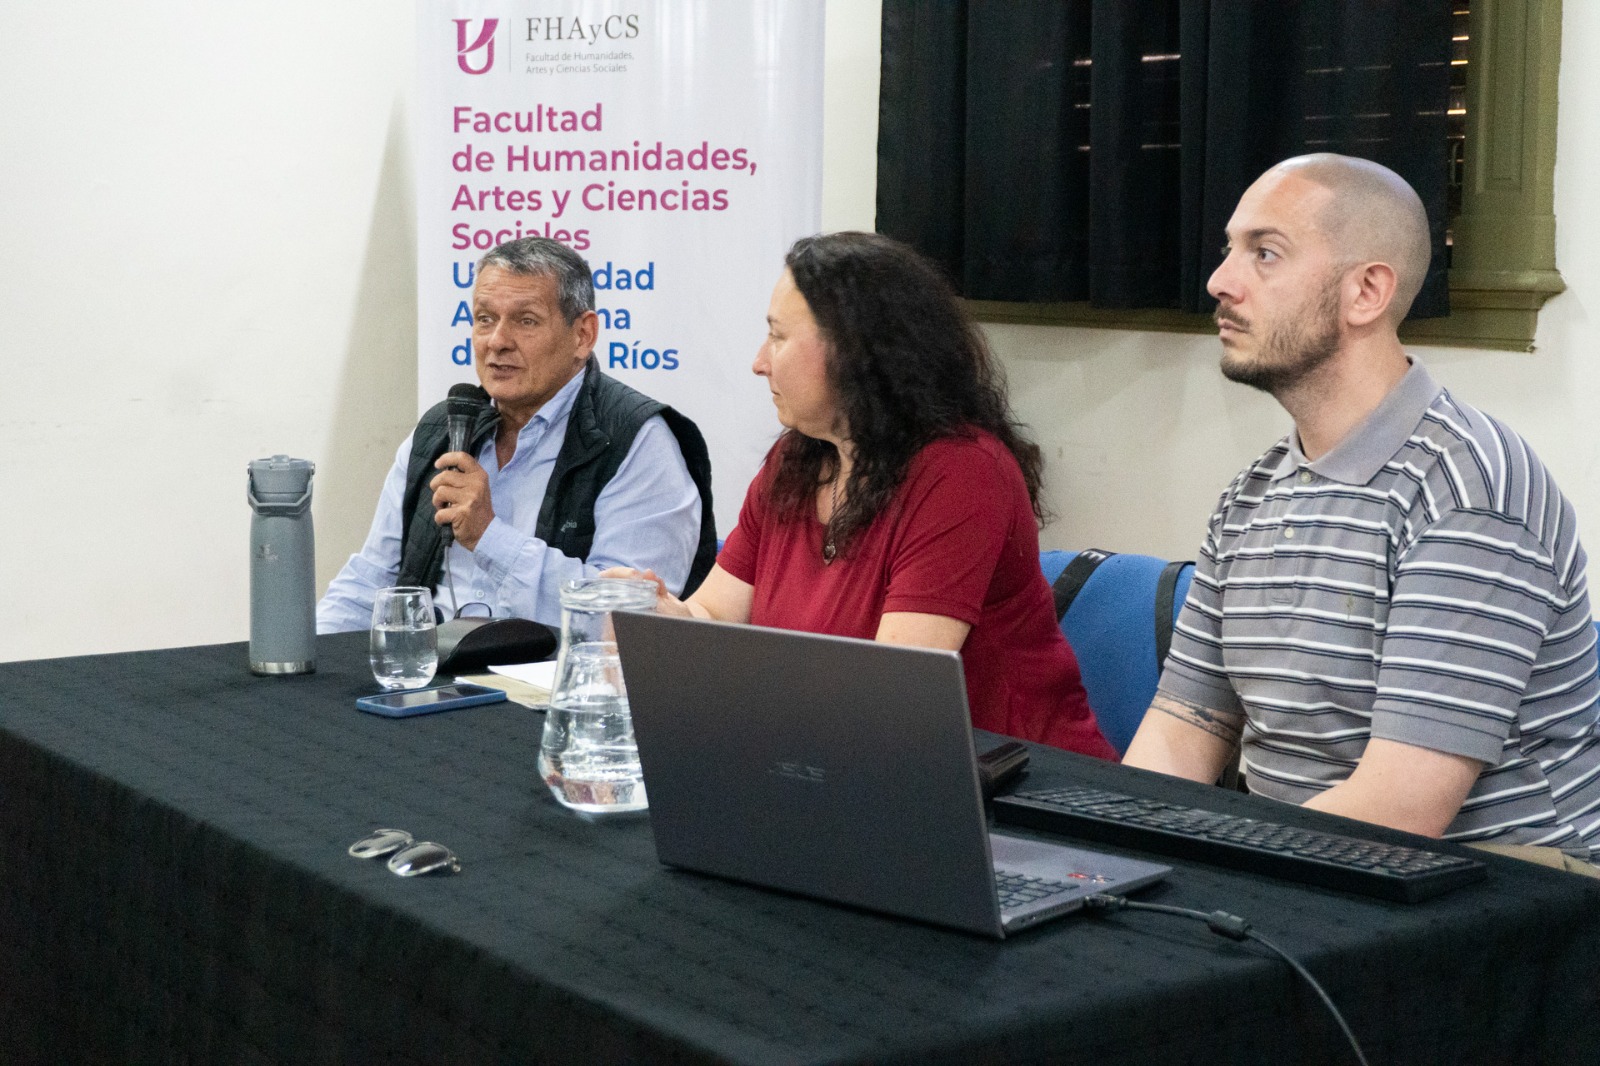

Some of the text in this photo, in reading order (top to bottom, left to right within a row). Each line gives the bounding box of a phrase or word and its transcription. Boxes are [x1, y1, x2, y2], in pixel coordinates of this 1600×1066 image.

[525, 14, 639, 46] FHAyCS
[526, 50, 635, 62] Facultad de Humanidades,
[526, 63, 628, 76] Artes y Ciencias Sociales
[453, 103, 602, 133] Facultad
[452, 140, 757, 176] de Humanidades,
[451, 180, 729, 218] Artes y Ciencias
[608, 340, 680, 371] Ríos
